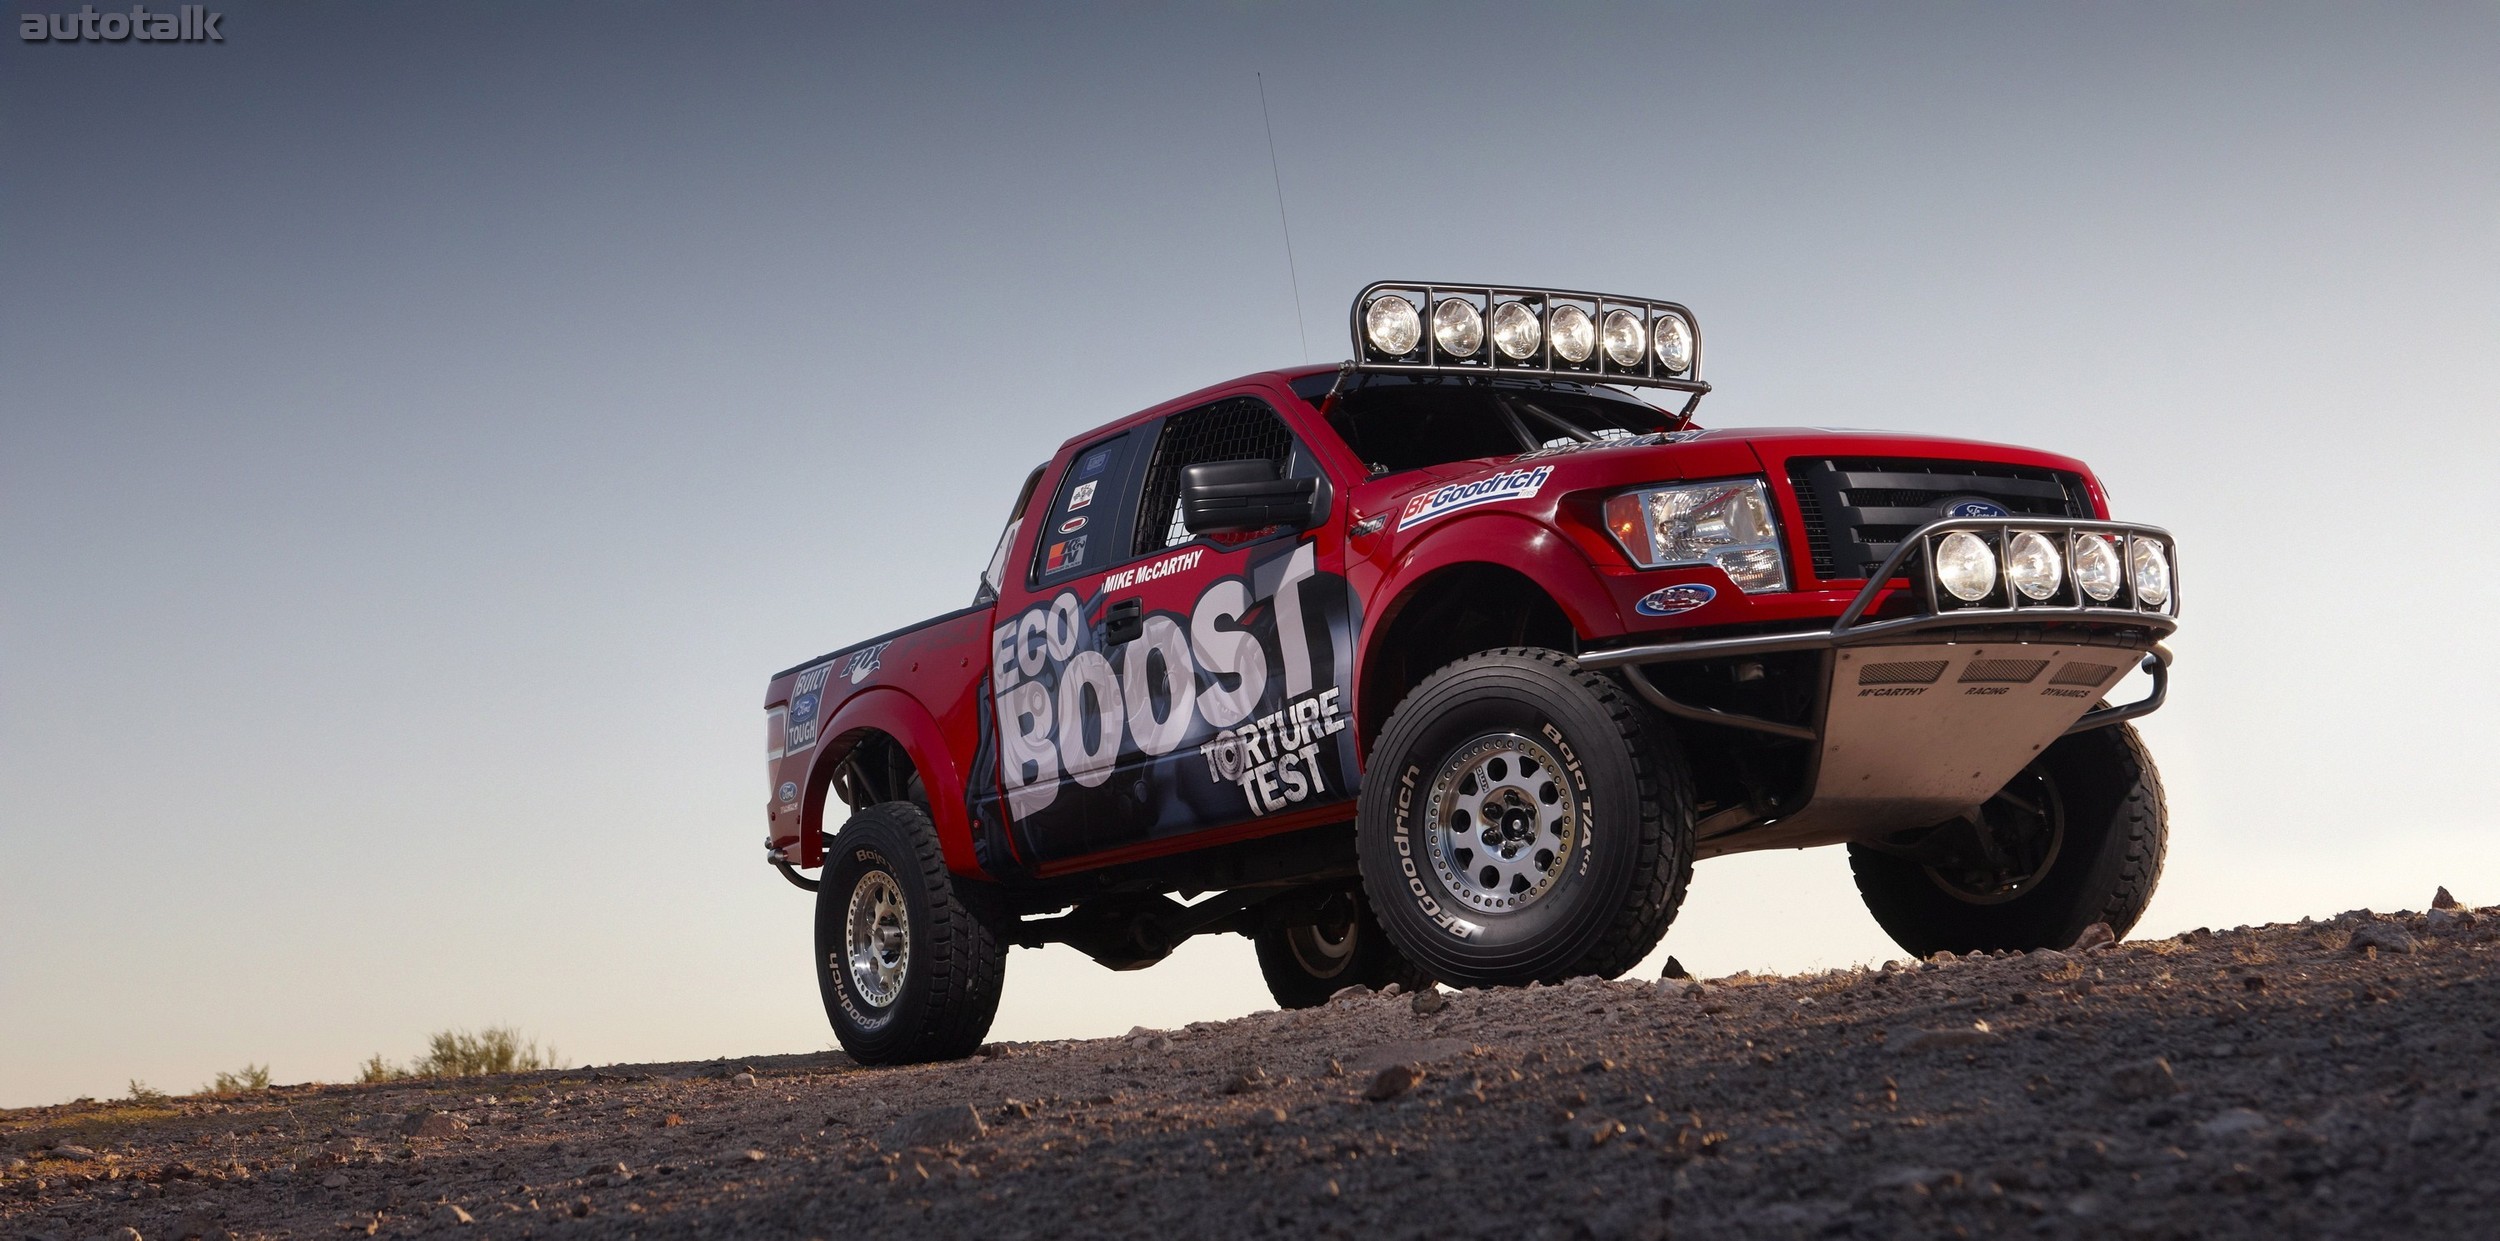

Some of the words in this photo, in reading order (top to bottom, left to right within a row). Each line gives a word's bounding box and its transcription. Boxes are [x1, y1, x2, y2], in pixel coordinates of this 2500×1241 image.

[1403, 467, 1549, 519] BFGoodrich
[1104, 569, 1135, 593] MIKE
[1135, 549, 1203, 584] McCARTHY
[993, 592, 1079, 691] ECO
[794, 665, 832, 697] BUILT
[1000, 541, 1315, 822] BOOST
[1965, 687, 2010, 696] RACING
[2040, 688, 2091, 699] DYNAMICS
[789, 718, 816, 747] TOUGH
[1200, 686, 1345, 783] TORTURE
[1239, 742, 1326, 817] TEST
[1542, 723, 1587, 791] Baja
[1581, 796, 1593, 848] T/A
[856, 849, 887, 866] Baja
[1393, 765, 1486, 939] BFGoodrich
